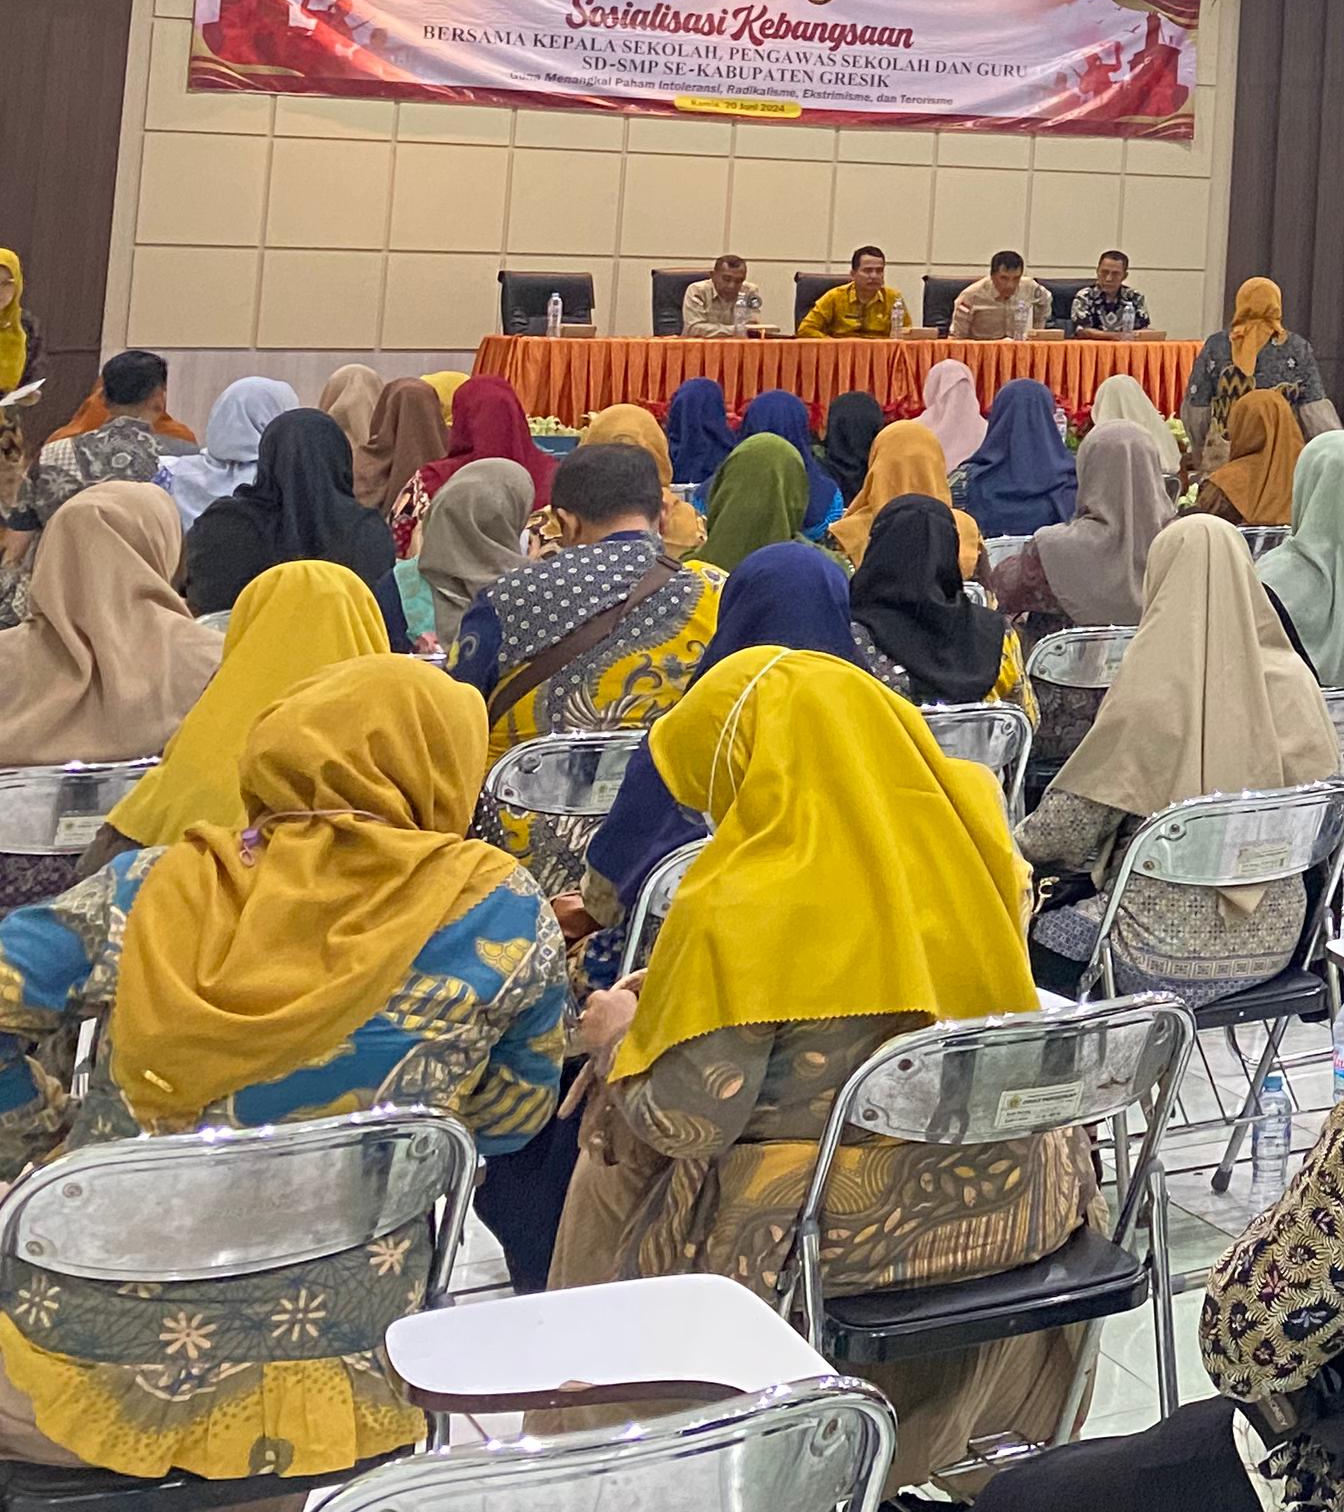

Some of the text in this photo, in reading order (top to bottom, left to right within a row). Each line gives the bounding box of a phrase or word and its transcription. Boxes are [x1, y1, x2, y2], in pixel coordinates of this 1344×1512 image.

[730, 4, 914, 52] Kebangsaan
[423, 25, 1029, 78] BERSAMA KEPALA SEKOLAH, PENGAWAS SEKOLAH DAN GURU
[582, 55, 891, 88] SD-SMP SE-KABUPATEN GRESIK
[615, 76, 656, 90] Paham
[876, 93, 897, 104] dan
[759, 103, 786, 113] 2024
